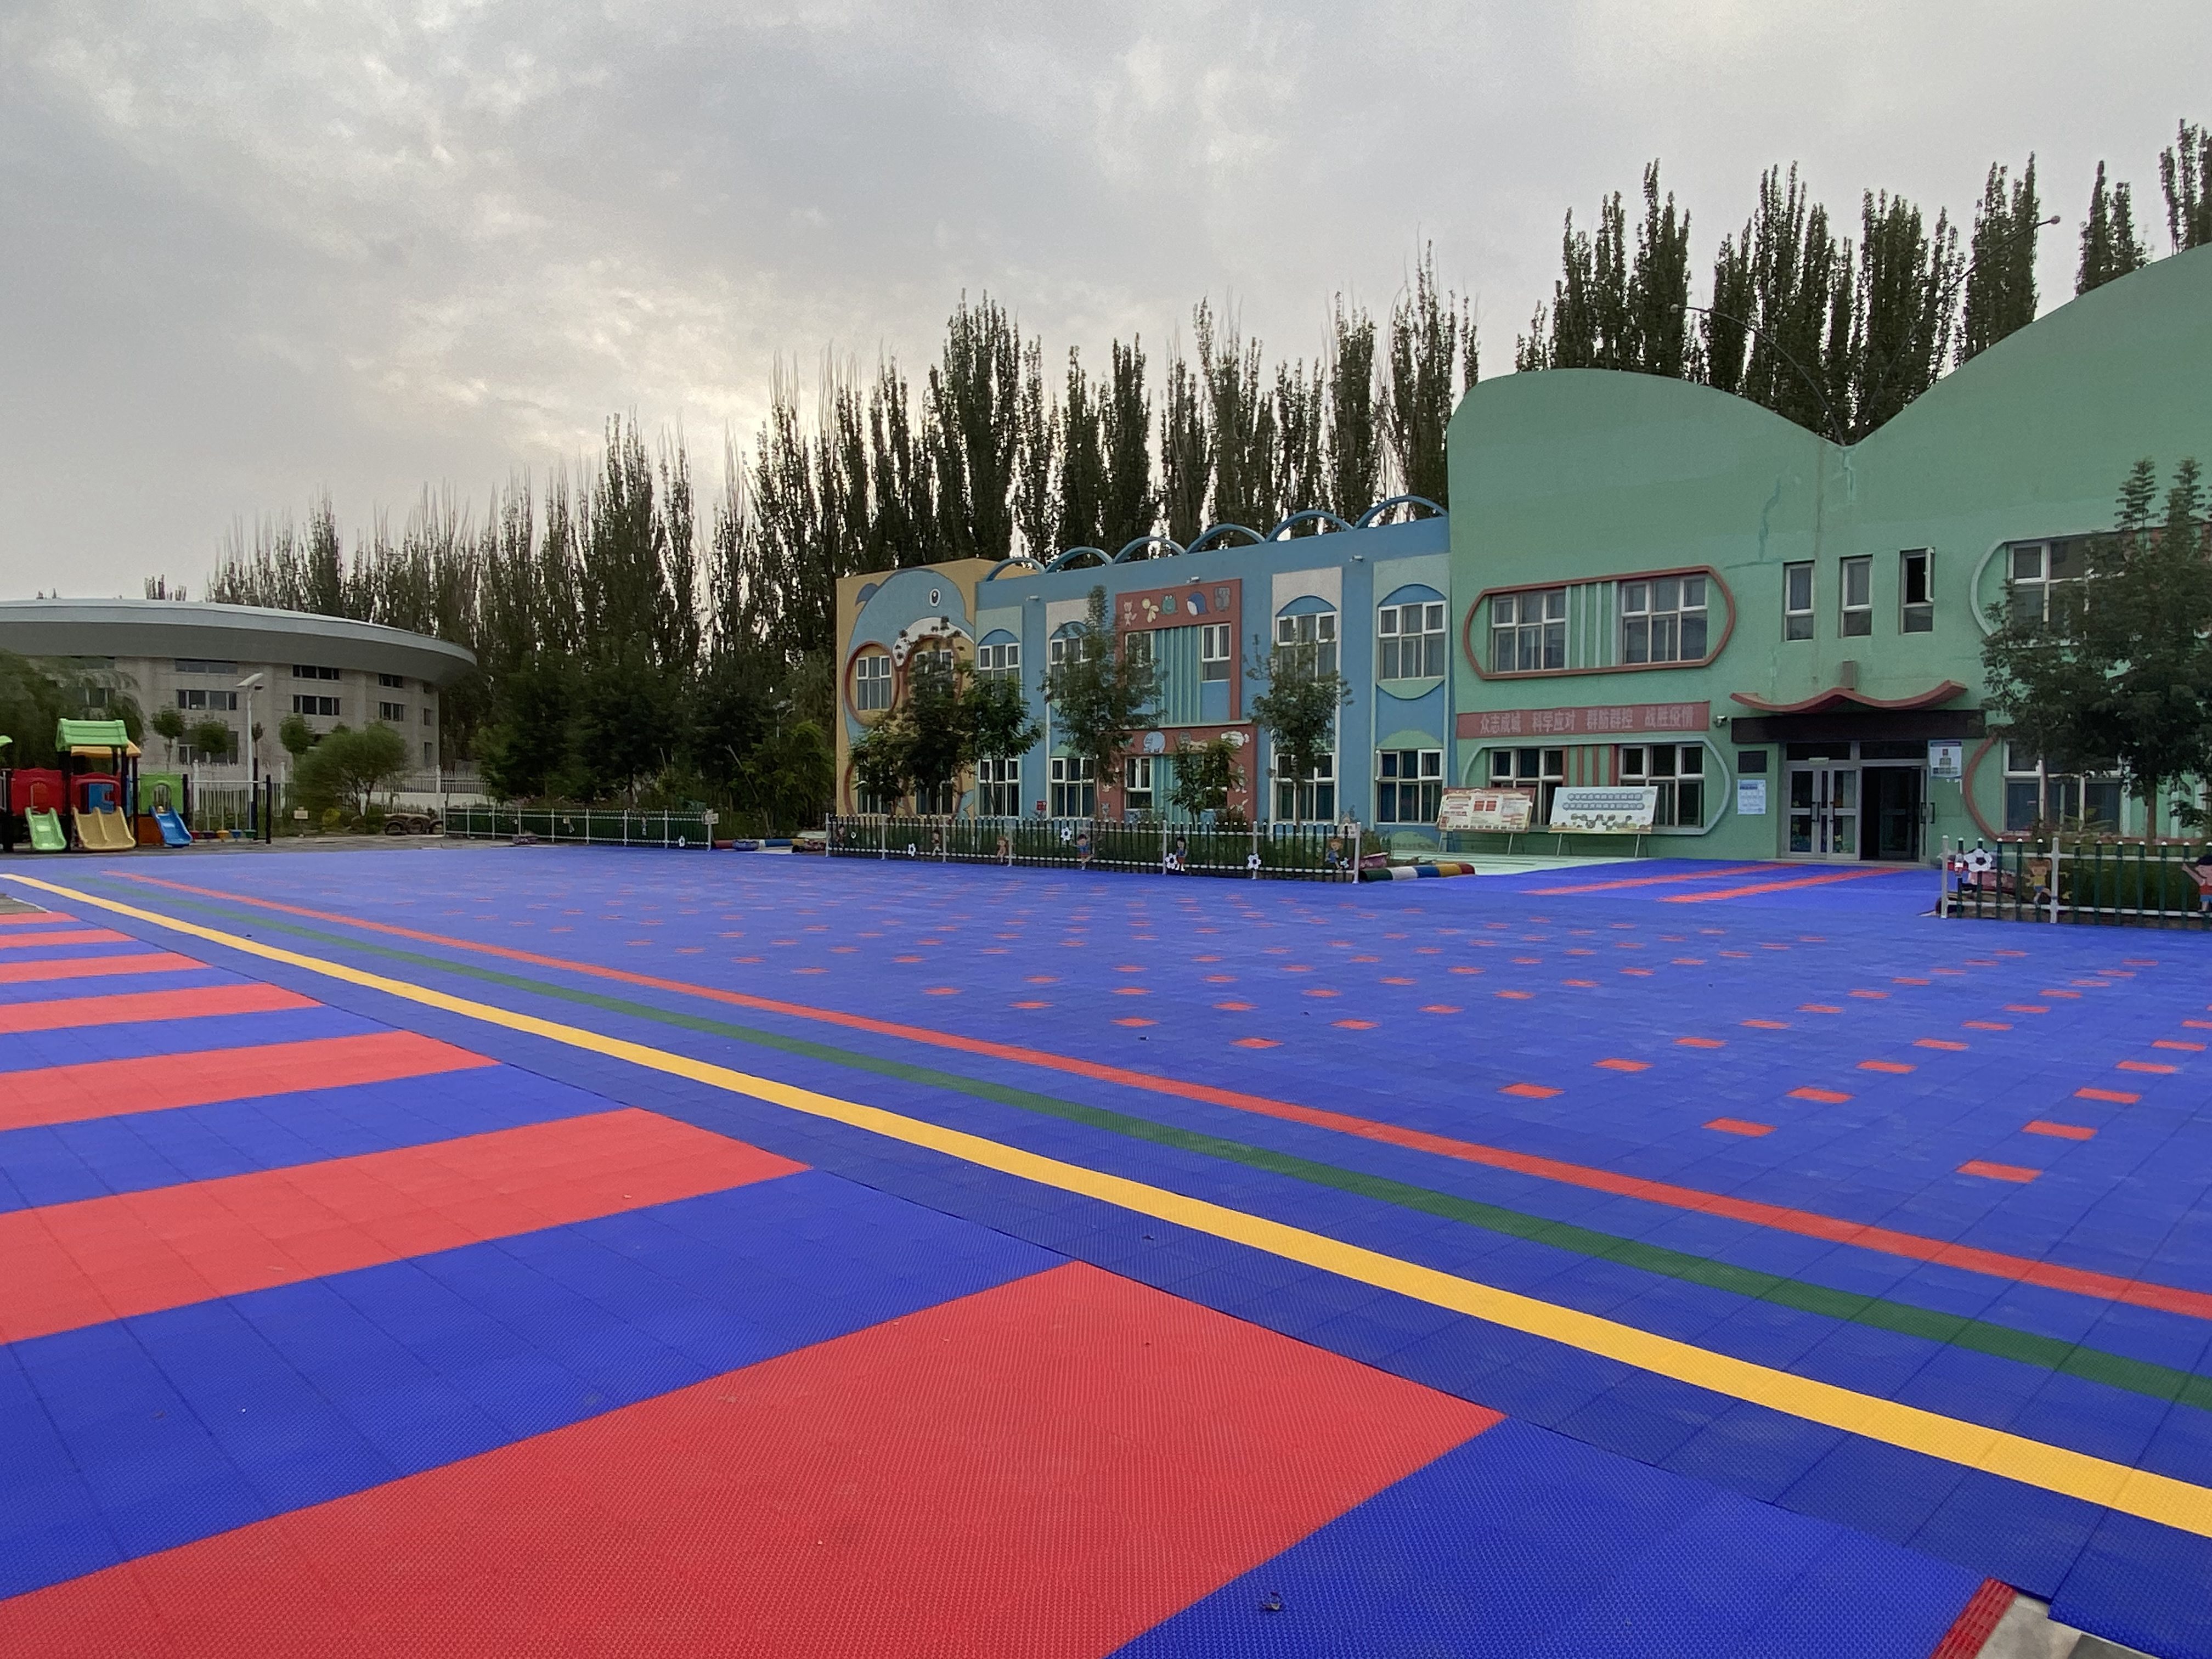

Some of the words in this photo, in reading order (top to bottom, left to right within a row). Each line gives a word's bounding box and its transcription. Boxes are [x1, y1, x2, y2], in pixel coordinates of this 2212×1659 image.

[1532, 710, 1576, 732] 科学应对
[1587, 708, 1633, 730] 群防群控
[1645, 706, 1694, 727] 战胜疫情
